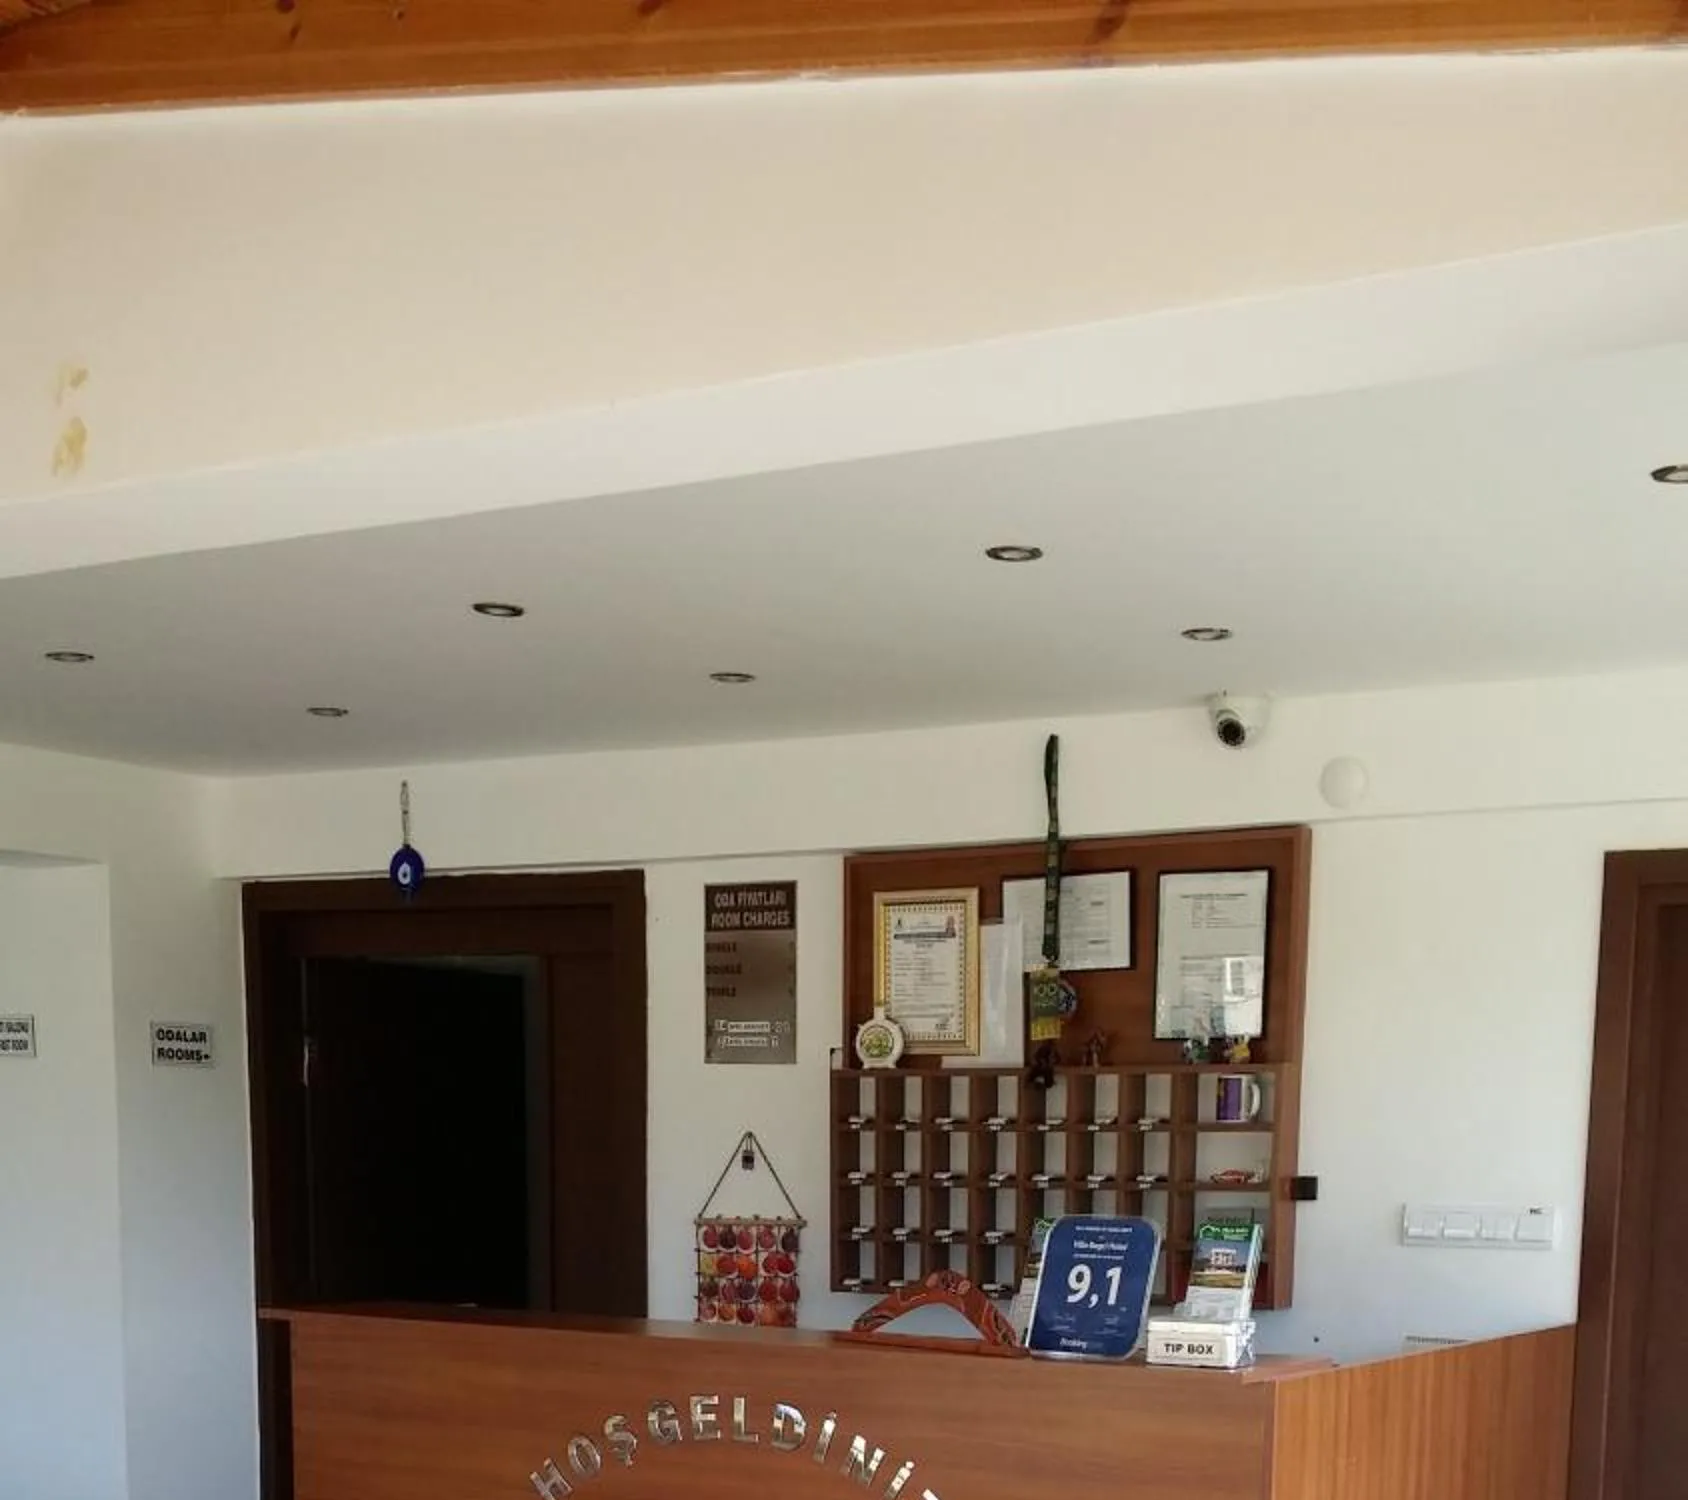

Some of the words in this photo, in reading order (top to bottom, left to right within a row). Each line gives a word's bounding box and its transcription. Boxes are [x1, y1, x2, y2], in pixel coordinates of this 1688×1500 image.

[711, 912, 741, 928] ROOM
[743, 910, 790, 927] CHARGES
[156, 1028, 207, 1043] ODALAR
[157, 1047, 203, 1061] ROOMS
[1067, 1264, 1122, 1308] 9,1
[1164, 1343, 1184, 1353] TIP
[1187, 1344, 1214, 1355] BOX
